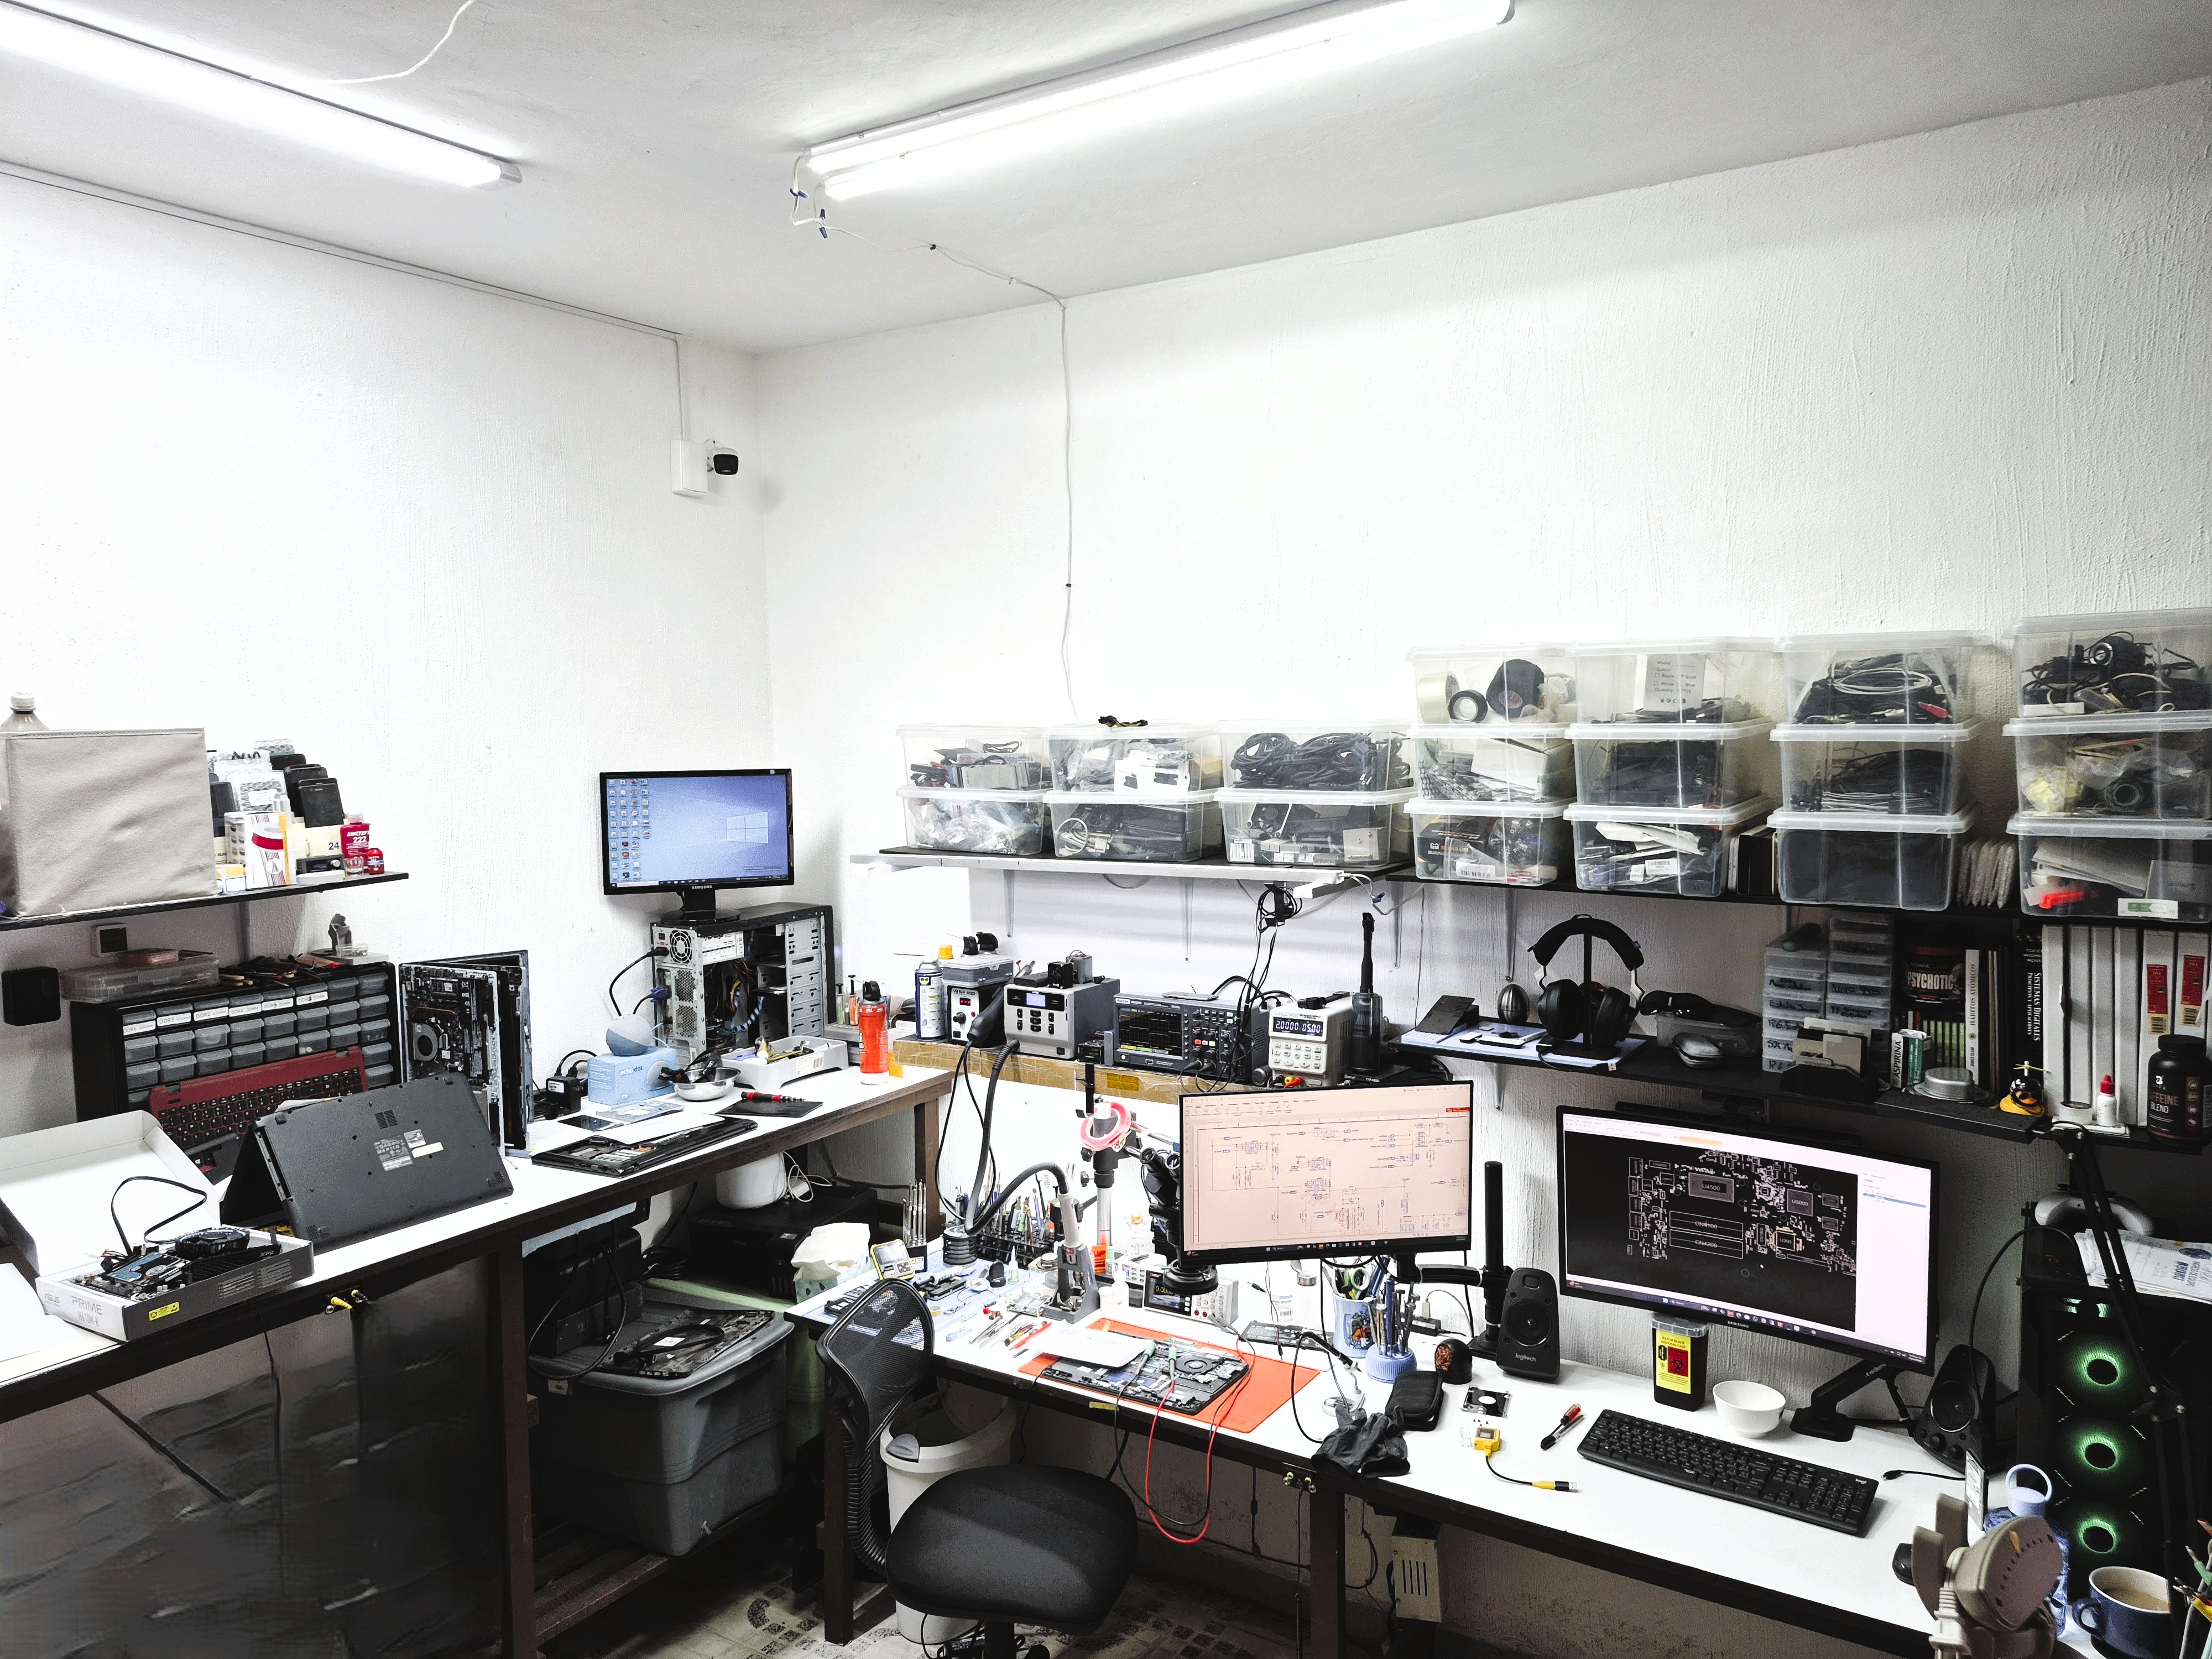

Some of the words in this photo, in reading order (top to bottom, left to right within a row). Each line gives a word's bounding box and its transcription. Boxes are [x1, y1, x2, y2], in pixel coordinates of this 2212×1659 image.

[353, 836, 367, 844] 222
[328, 842, 340, 851] 24
[1908, 972, 1954, 990] PSYCHOTIC
[2033, 972, 2042, 1006] SISTEMAS
[2033, 1007, 2042, 1041] DIGITALES
[1893, 1041, 1901, 1078] ASPIRINA
[620, 1067, 634, 1076] echo
[2150, 1101, 2169, 1114] BLEND
[1702, 1183, 1721, 1191] U4500
[71, 1295, 103, 1316] PRIME
[1727, 1320, 1750, 1328] SAMSUNG
[1515, 1352, 1536, 1362] logitech
